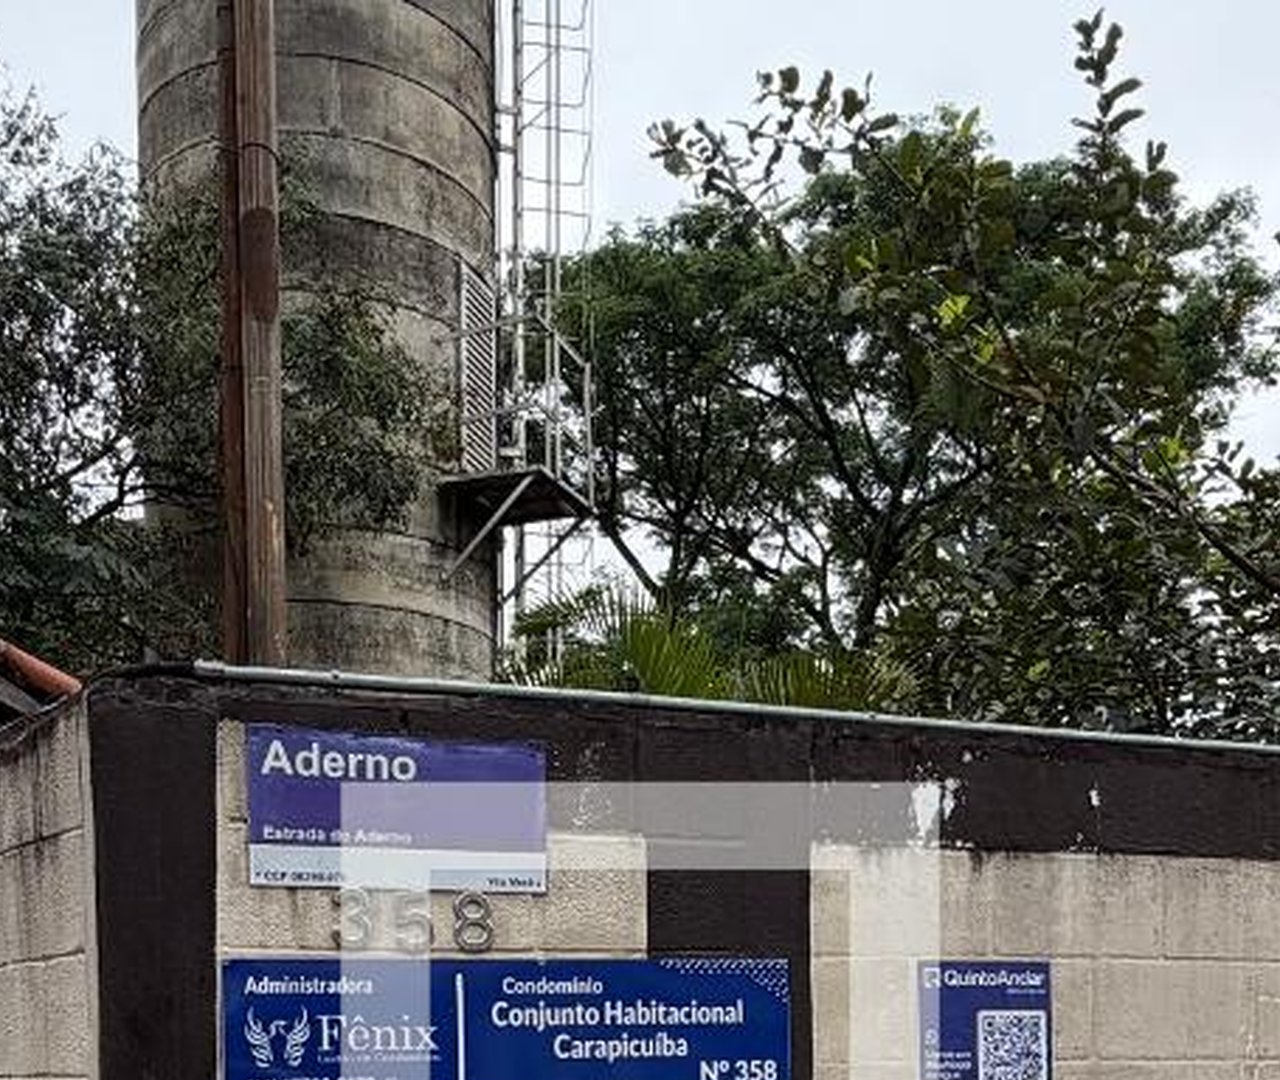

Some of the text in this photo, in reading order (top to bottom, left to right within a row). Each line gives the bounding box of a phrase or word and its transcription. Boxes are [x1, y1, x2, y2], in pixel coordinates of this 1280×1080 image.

[261, 739, 417, 781] Aderno
[263, 824, 326, 841] Estrada
[331, 886, 494, 953] 358
[244, 975, 374, 995] Administradora
[502, 976, 604, 995] Condomínio
[944, 969, 1045, 988] QuintoAndar
[491, 998, 744, 1031] Conjunto Habitacional
[316, 1014, 440, 1051] Fênix
[553, 1032, 688, 1063] Carapicuíba
